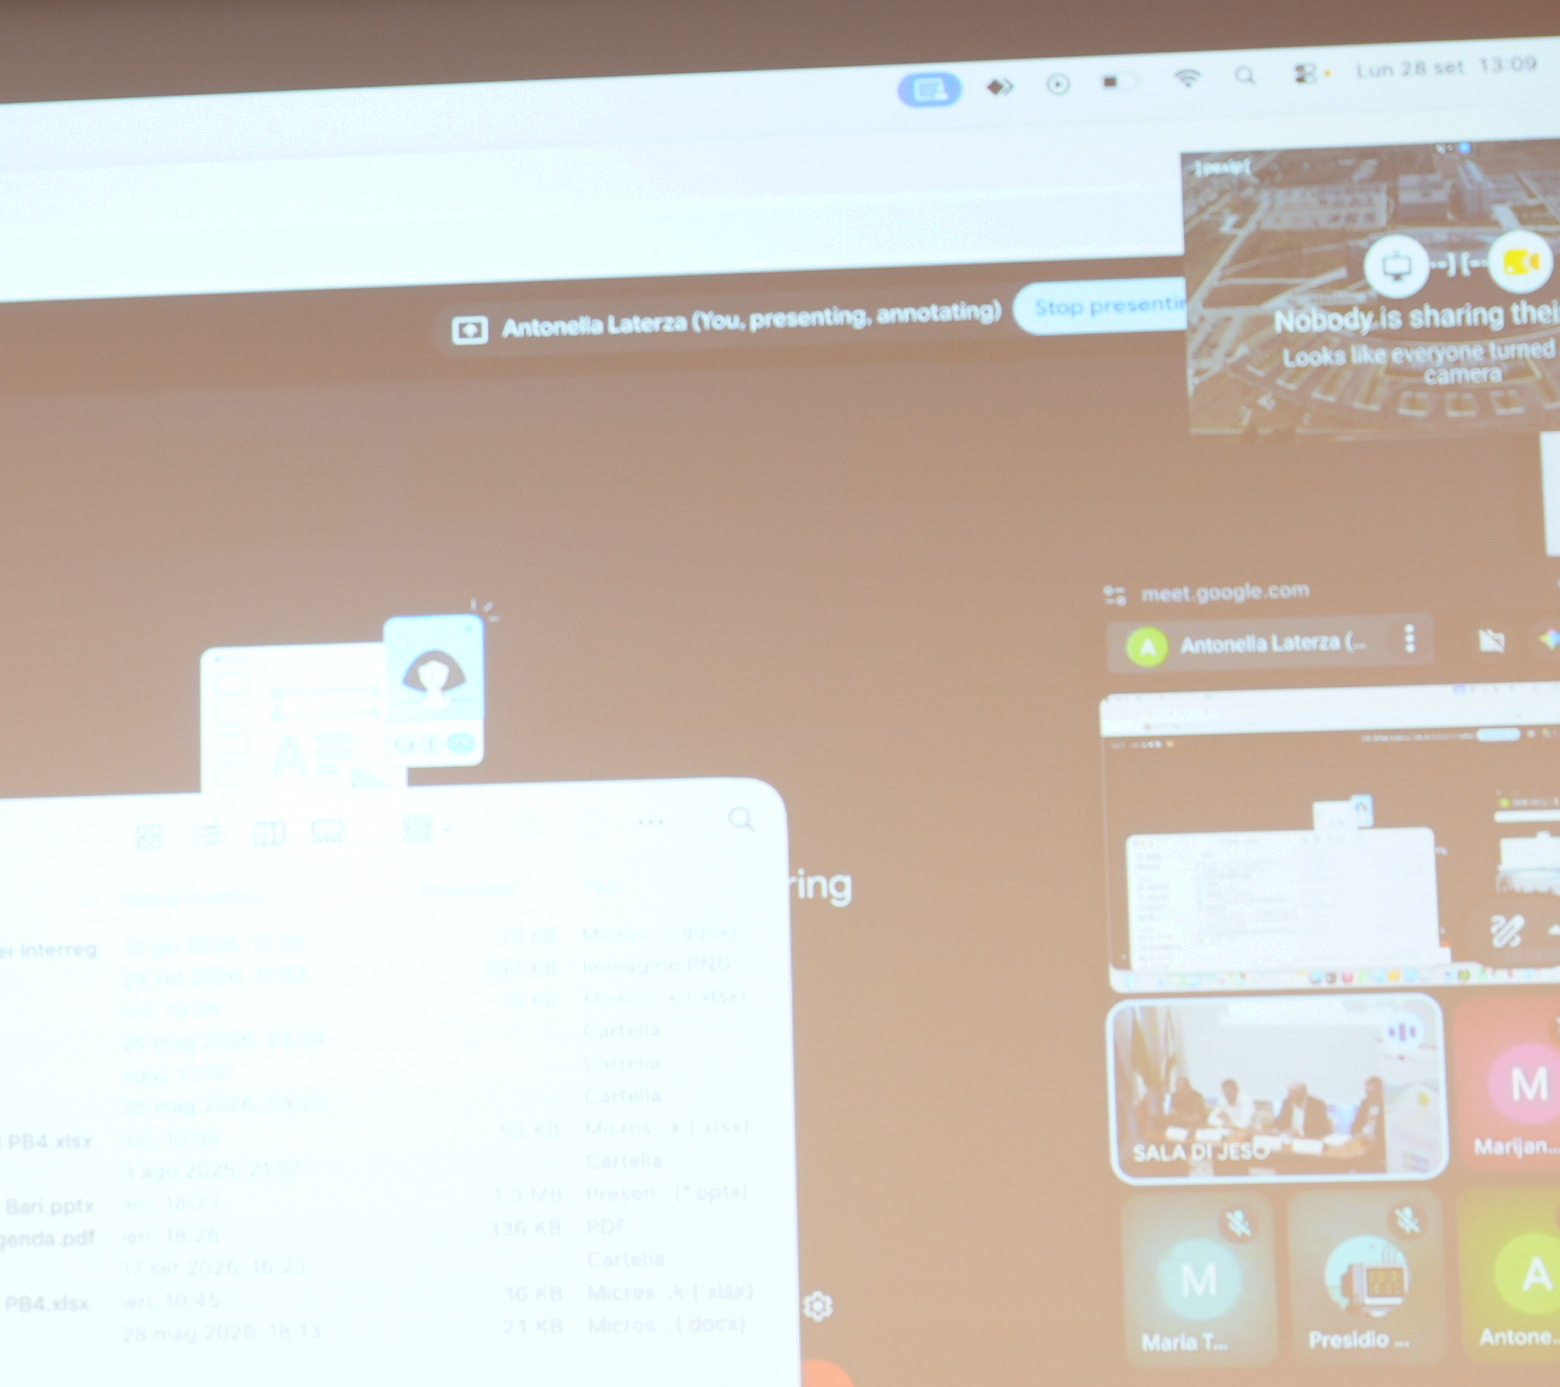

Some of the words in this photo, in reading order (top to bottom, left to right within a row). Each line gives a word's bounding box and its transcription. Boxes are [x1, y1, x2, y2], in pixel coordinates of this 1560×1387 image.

[1356, 58, 1397, 80] Lun
[1401, 57, 1429, 78] 28
[1433, 55, 1465, 77] set
[1478, 53, 1538, 76] 13:09
[502, 316, 604, 339] Antonella
[608, 313, 687, 336] Laterza
[692, 310, 746, 334] (You,
[750, 306, 872, 332] presenting,
[877, 298, 1002, 327] annotating)
[1035, 298, 1084, 318] Stop
[1274, 307, 1374, 335] Nobody
[1380, 306, 1402, 328] is
[1408, 303, 1504, 331] sharing
[1283, 346, 1346, 368] Looks
[1352, 345, 1386, 366] like
[1392, 345, 1484, 368] everyone
[1489, 341, 1555, 362] turned
[1424, 364, 1503, 386] camera
[1141, 582, 1310, 605] meet.google.com
[1181, 634, 1268, 655] Antonella
[1273, 633, 1340, 652] Laterza
[1511, 1067, 1549, 1101] M
[1133, 1142, 1186, 1162] SALA
[1181, 1263, 1218, 1298] M
[1521, 1257, 1554, 1291] A
[1141, 1333, 1197, 1352] Maria
[1309, 1330, 1390, 1350] Presidio
